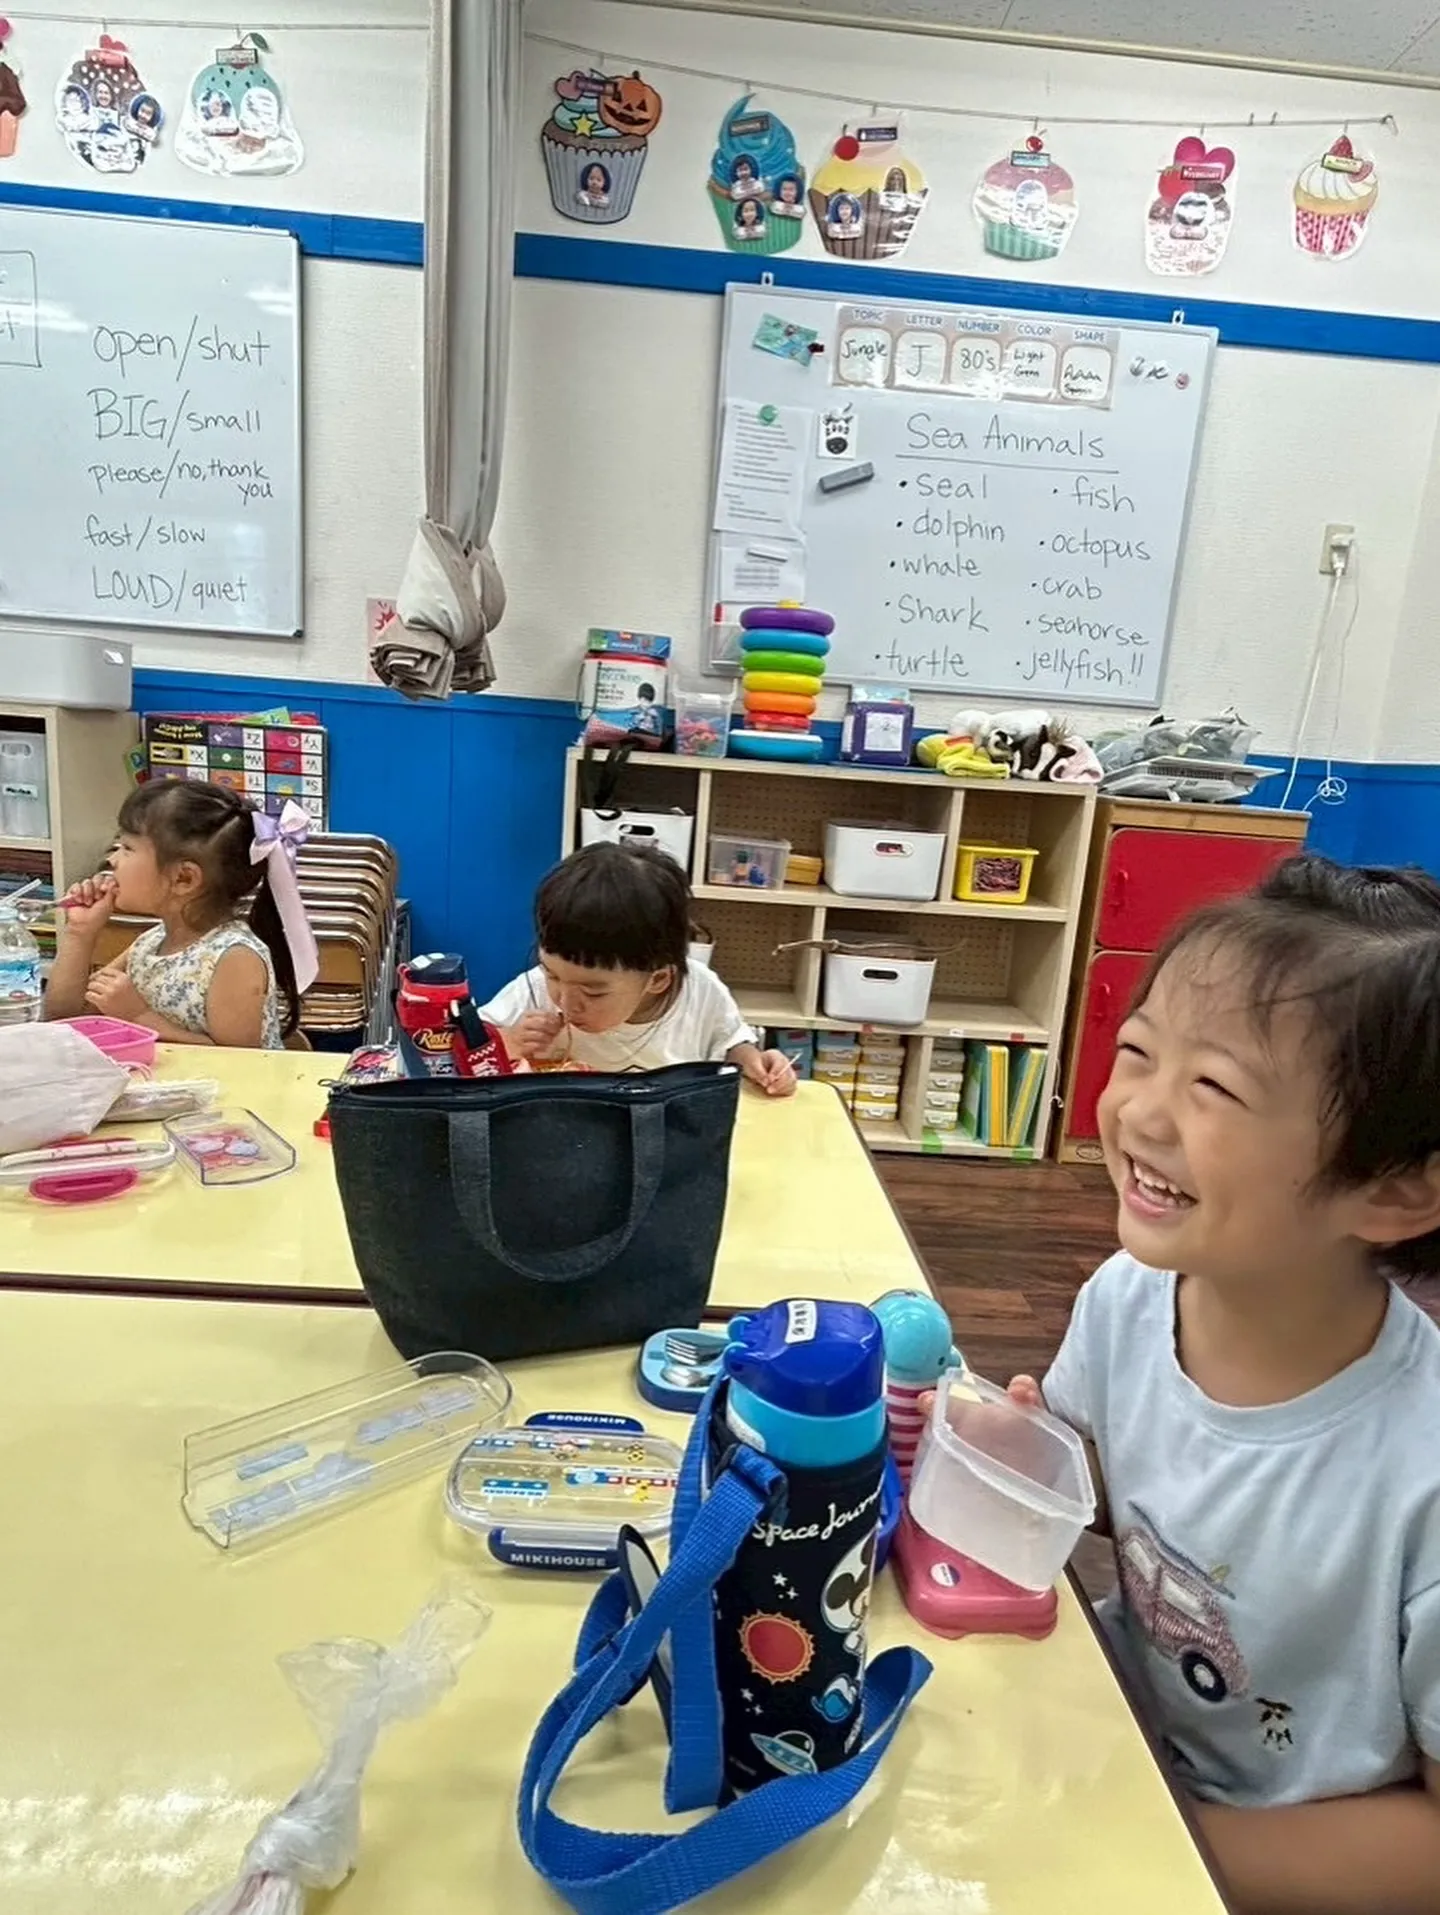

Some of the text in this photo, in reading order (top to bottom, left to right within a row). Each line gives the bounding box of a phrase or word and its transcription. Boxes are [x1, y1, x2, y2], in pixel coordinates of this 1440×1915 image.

[854, 309, 884, 322] TOPIC
[906, 315, 943, 327] LETTER
[957, 320, 1000, 333] NUMBER
[1017, 324, 1052, 336] COLOR
[1073, 330, 1105, 342] SHAPE
[841, 338, 888, 361] Jungle
[906, 344, 932, 377] J
[906, 413, 1105, 458] Sea Animals
[237, 481, 274, 506] you
[1072, 477, 1135, 513] fish
[912, 510, 1005, 547] dolphin
[1051, 531, 1151, 568] octopus
[902, 555, 982, 579] whale
[1042, 575, 1103, 600] crab
[1037, 613, 1150, 646] seahorse
[884, 640, 969, 678] turtle
[304, 734, 318, 749] Yy
[510, 1553, 606, 1567] MIKIHOUSE
